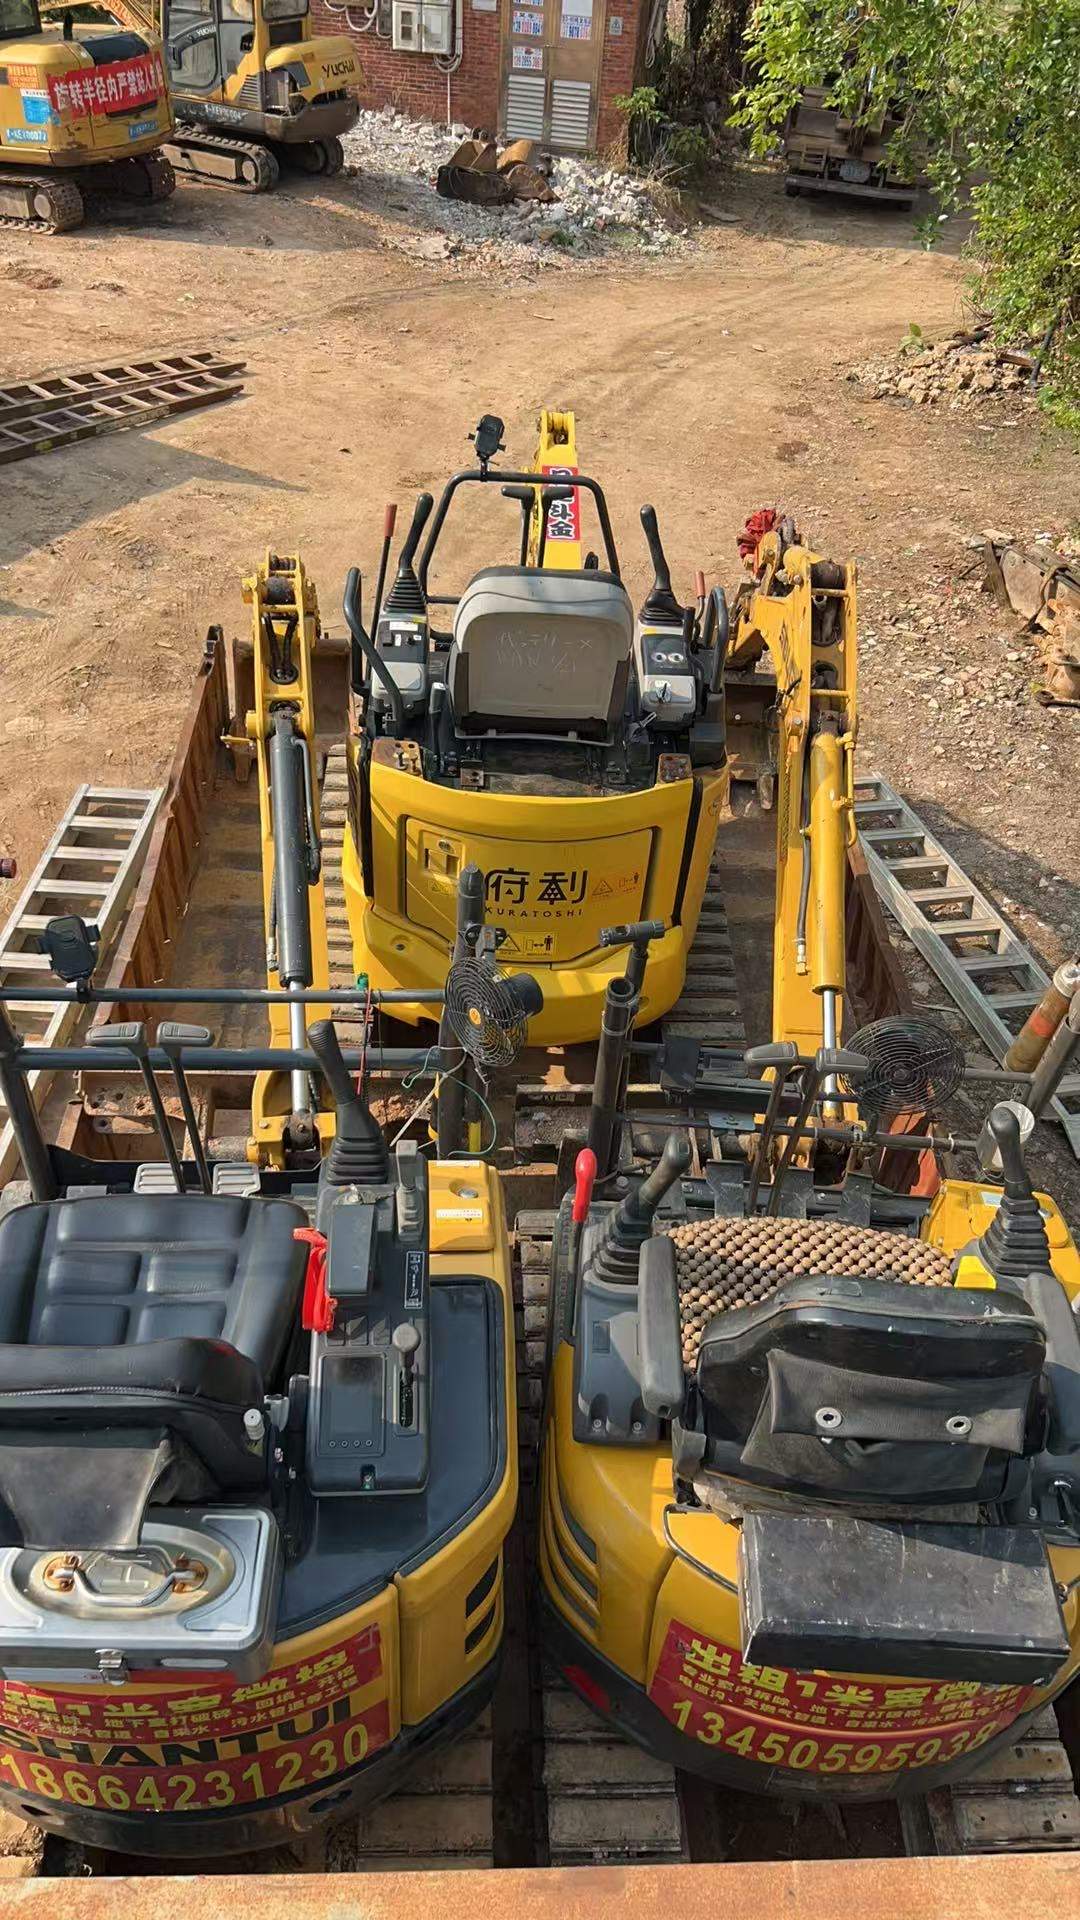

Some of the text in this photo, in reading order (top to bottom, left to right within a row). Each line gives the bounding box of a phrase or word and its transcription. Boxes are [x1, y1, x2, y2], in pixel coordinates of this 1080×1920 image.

[322, 59, 356, 78] YUCHAI
[548, 468, 575, 538] 斗金
[485, 908, 583, 918] KURATOSHI
[0, 1695, 351, 1767] SHANTUI
[672, 1699, 998, 1773] 13450595938
[1, 1723, 369, 1811] 18664231230
